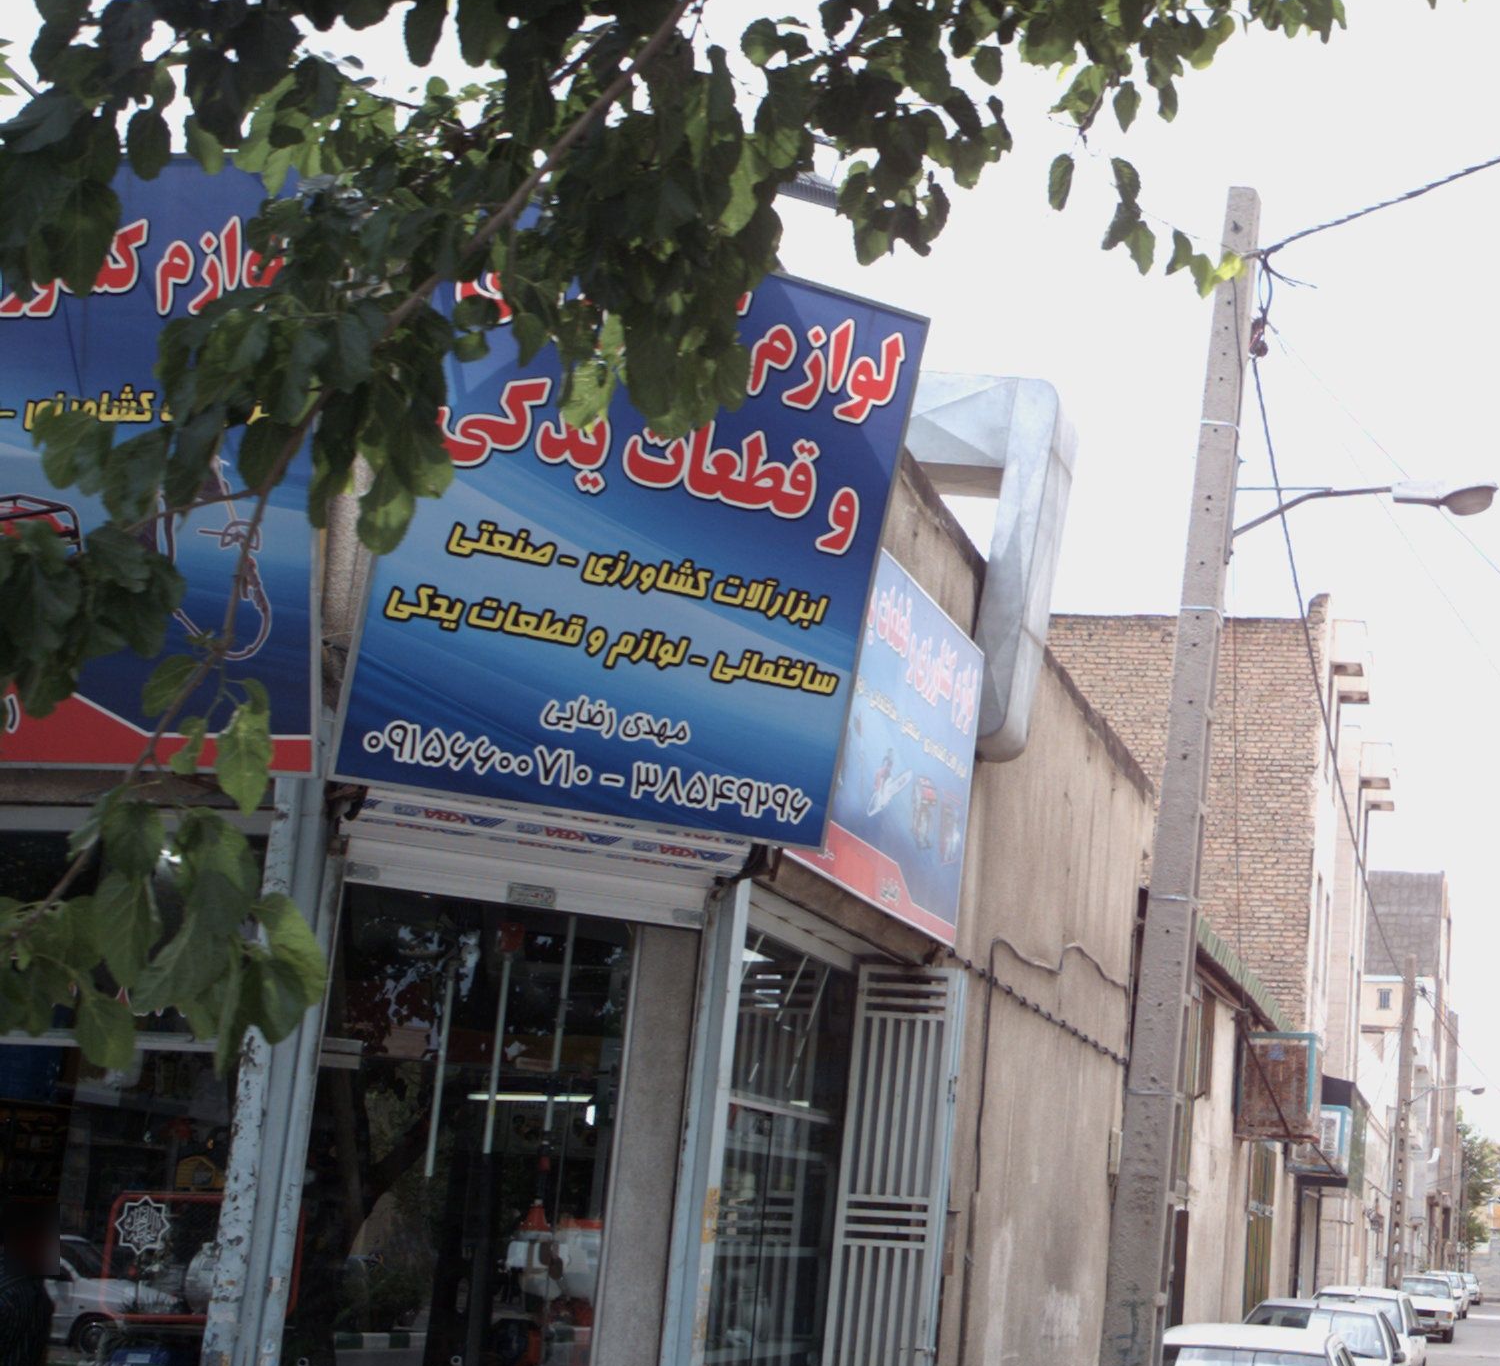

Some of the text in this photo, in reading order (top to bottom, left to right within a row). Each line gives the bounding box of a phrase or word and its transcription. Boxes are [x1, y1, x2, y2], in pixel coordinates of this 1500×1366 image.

[748, 318, 905, 423] لوازم
[438, 378, 859, 555] و قطعات یدکی
[446, 521, 557, 566] صنعتی
[583, 552, 712, 599] کشاورزی
[385, 584, 465, 632] یدکی
[467, 598, 586, 646] قطعات
[586, 626, 608, 655] و
[603, 629, 690, 669] لوازم
[711, 650, 839, 695] ساختمانی
[541, 696, 690, 747] مهدی رضایی
